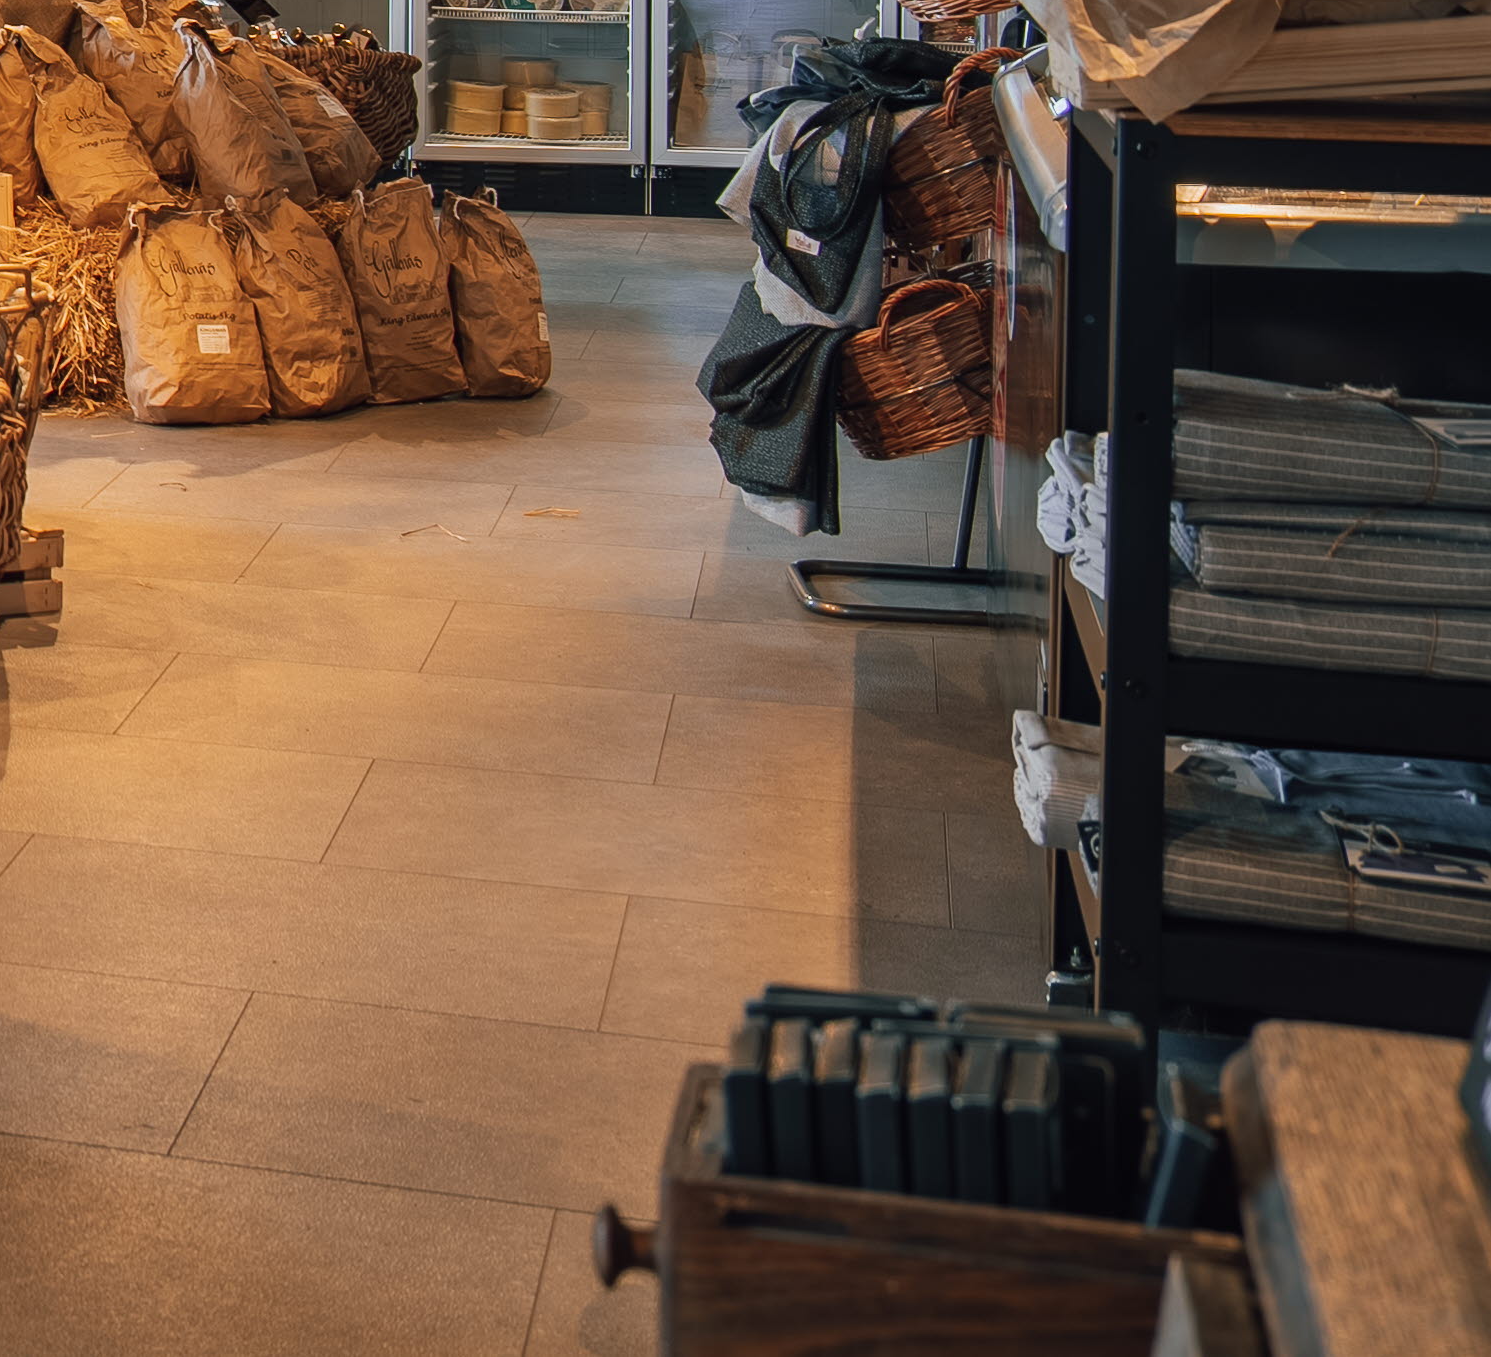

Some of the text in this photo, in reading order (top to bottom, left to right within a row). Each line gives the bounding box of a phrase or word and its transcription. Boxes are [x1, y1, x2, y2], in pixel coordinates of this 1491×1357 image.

[183, 312, 217, 321] Potatis
[380, 311, 439, 326] King Edward
